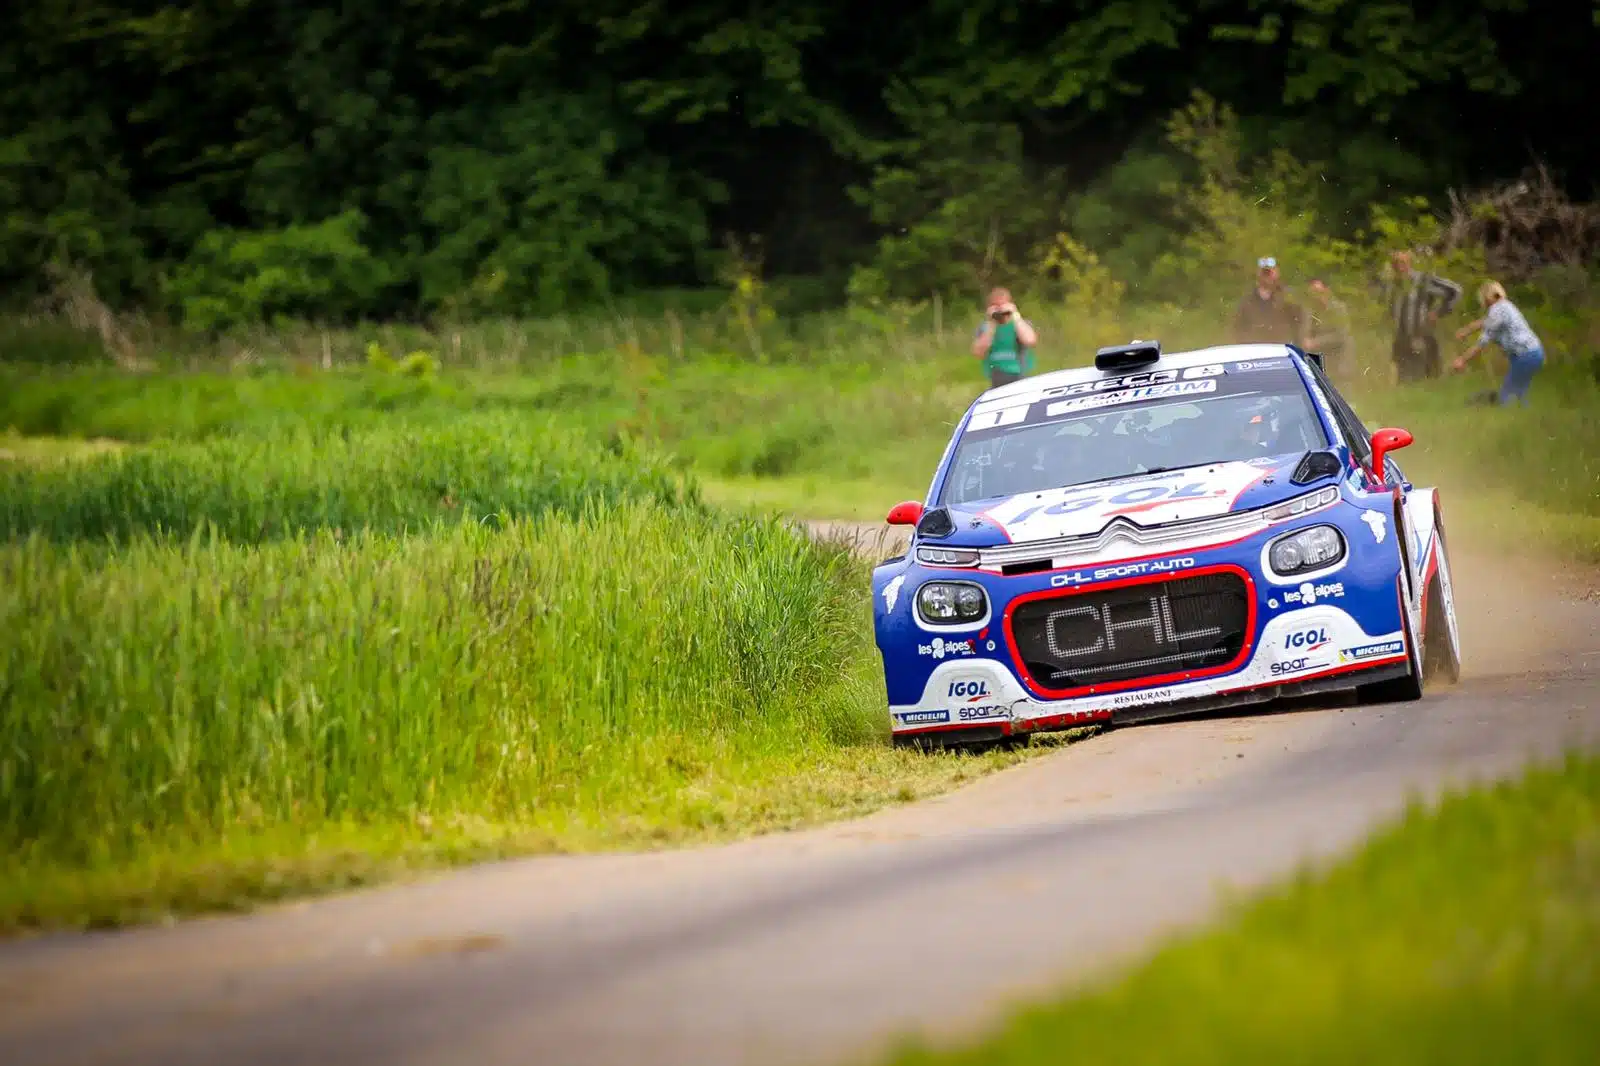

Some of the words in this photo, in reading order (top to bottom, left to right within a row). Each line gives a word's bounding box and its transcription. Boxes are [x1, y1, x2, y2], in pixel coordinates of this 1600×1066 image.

[994, 411, 1004, 425] 1
[1051, 572, 1092, 588] CHL
[1094, 562, 1151, 581] SPORT
[1148, 556, 1195, 571] AUTO
[1045, 594, 1222, 659] CHL
[1355, 642, 1402, 656] MICHELIN
[1113, 689, 1172, 705] RESTAURANT
[906, 711, 948, 722] MICHELIN
